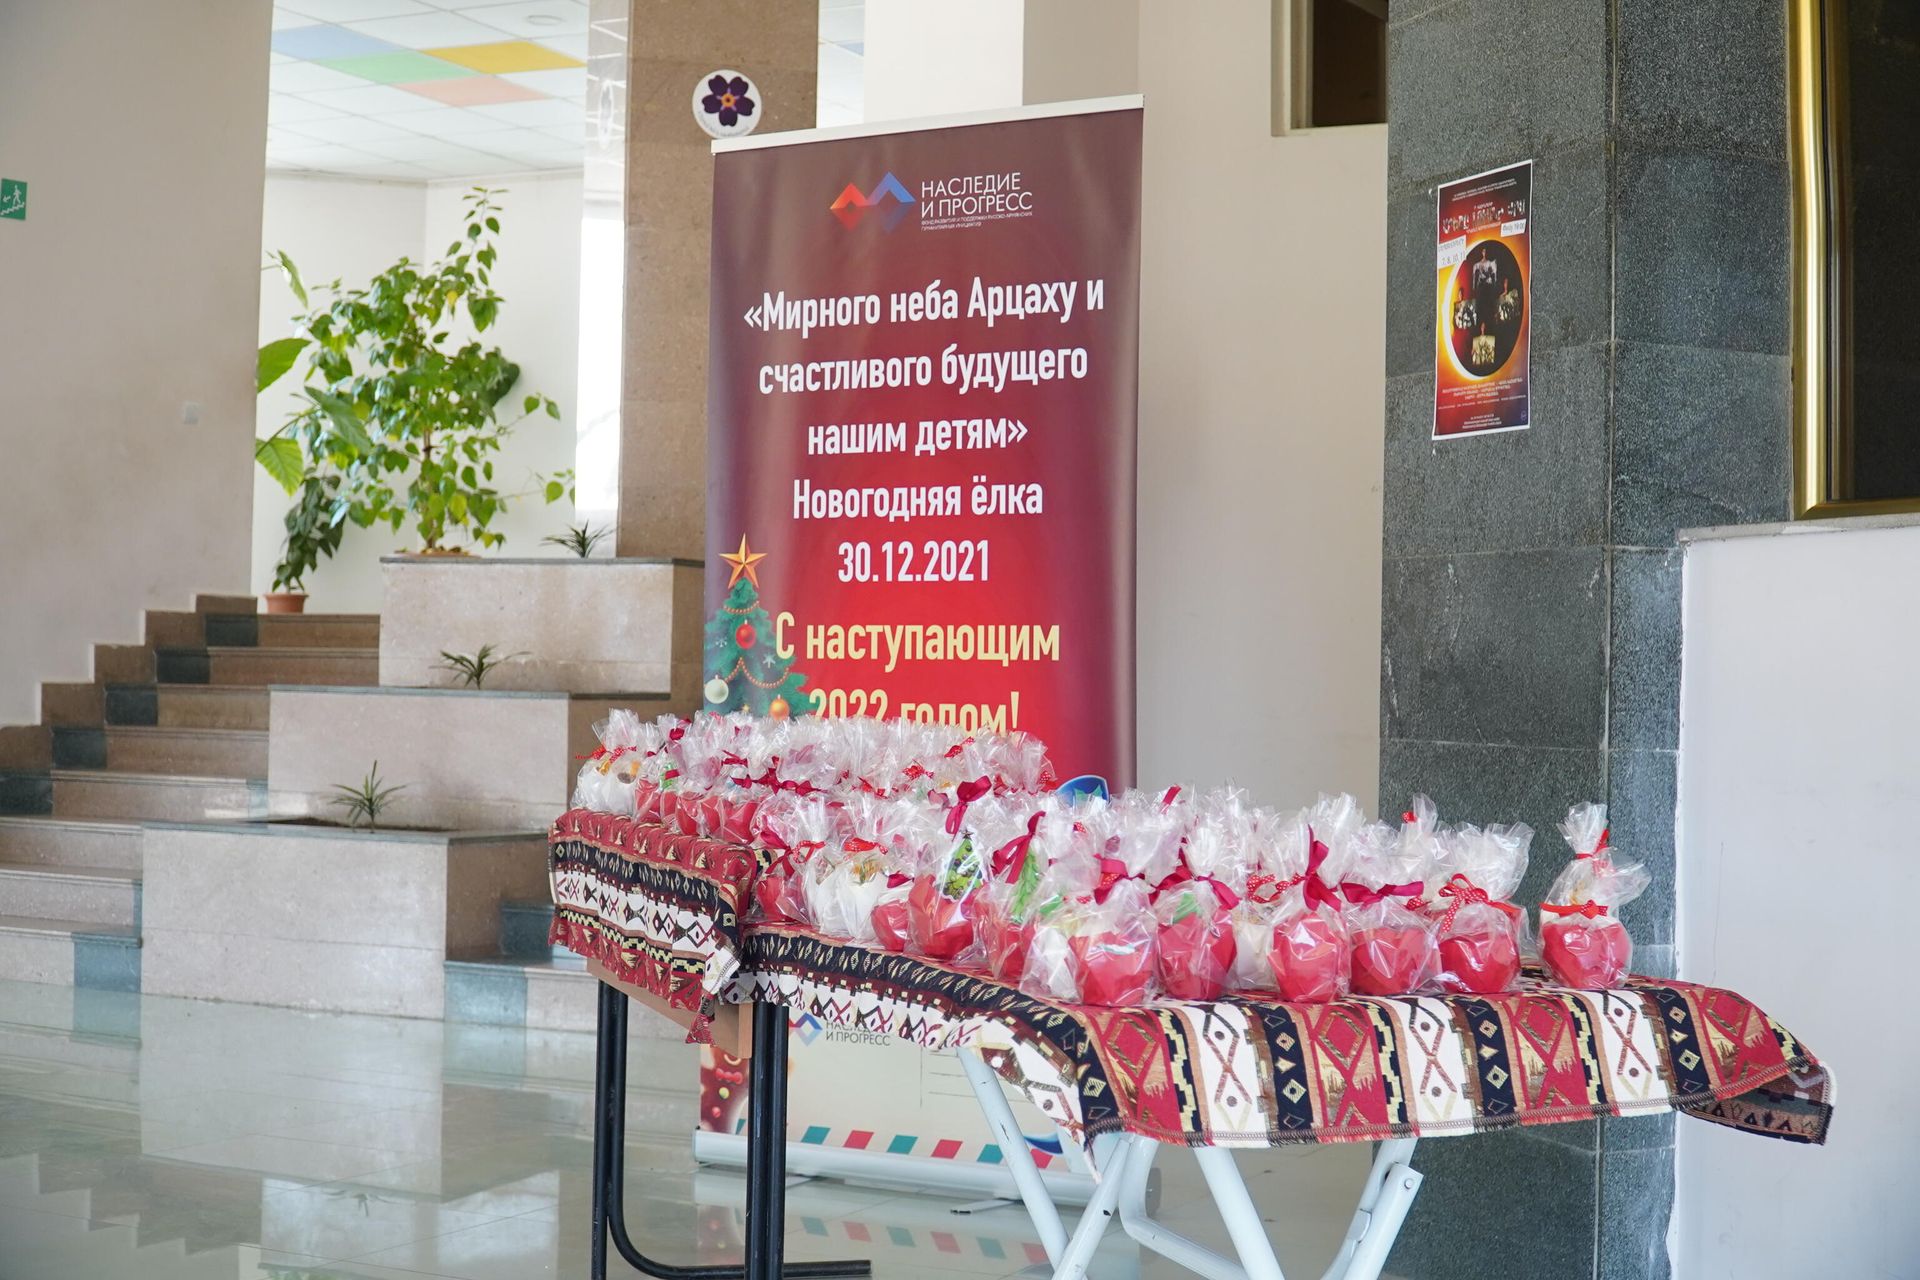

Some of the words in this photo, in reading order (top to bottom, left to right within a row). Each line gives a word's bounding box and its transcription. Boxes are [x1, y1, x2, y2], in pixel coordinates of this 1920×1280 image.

[921, 172, 1021, 199] НАСЛЕДИЕ
[921, 201, 934, 219] И
[939, 191, 1033, 217] ПРОГРЕСС
[744, 290, 880, 339] «Мирного
[890, 280, 958, 322] неба
[967, 276, 1077, 328] Арцаху
[1087, 279, 1104, 310] и
[759, 355, 931, 394] счастливого
[941, 343, 1088, 395] будущего
[808, 422, 906, 455] нашим
[914, 417, 1028, 457] детям»
[793, 479, 961, 522] Новогодняя
[971, 475, 1043, 515] ёлка
[838, 540, 989, 583] 30.12.2021
[776, 611, 795, 660] С
[806, 624, 1060, 673] наступающим
[809, 688, 888, 720] 2022
[826, 1031, 833, 1040] И
[837, 1031, 890, 1046] ПРОГРЕСС
